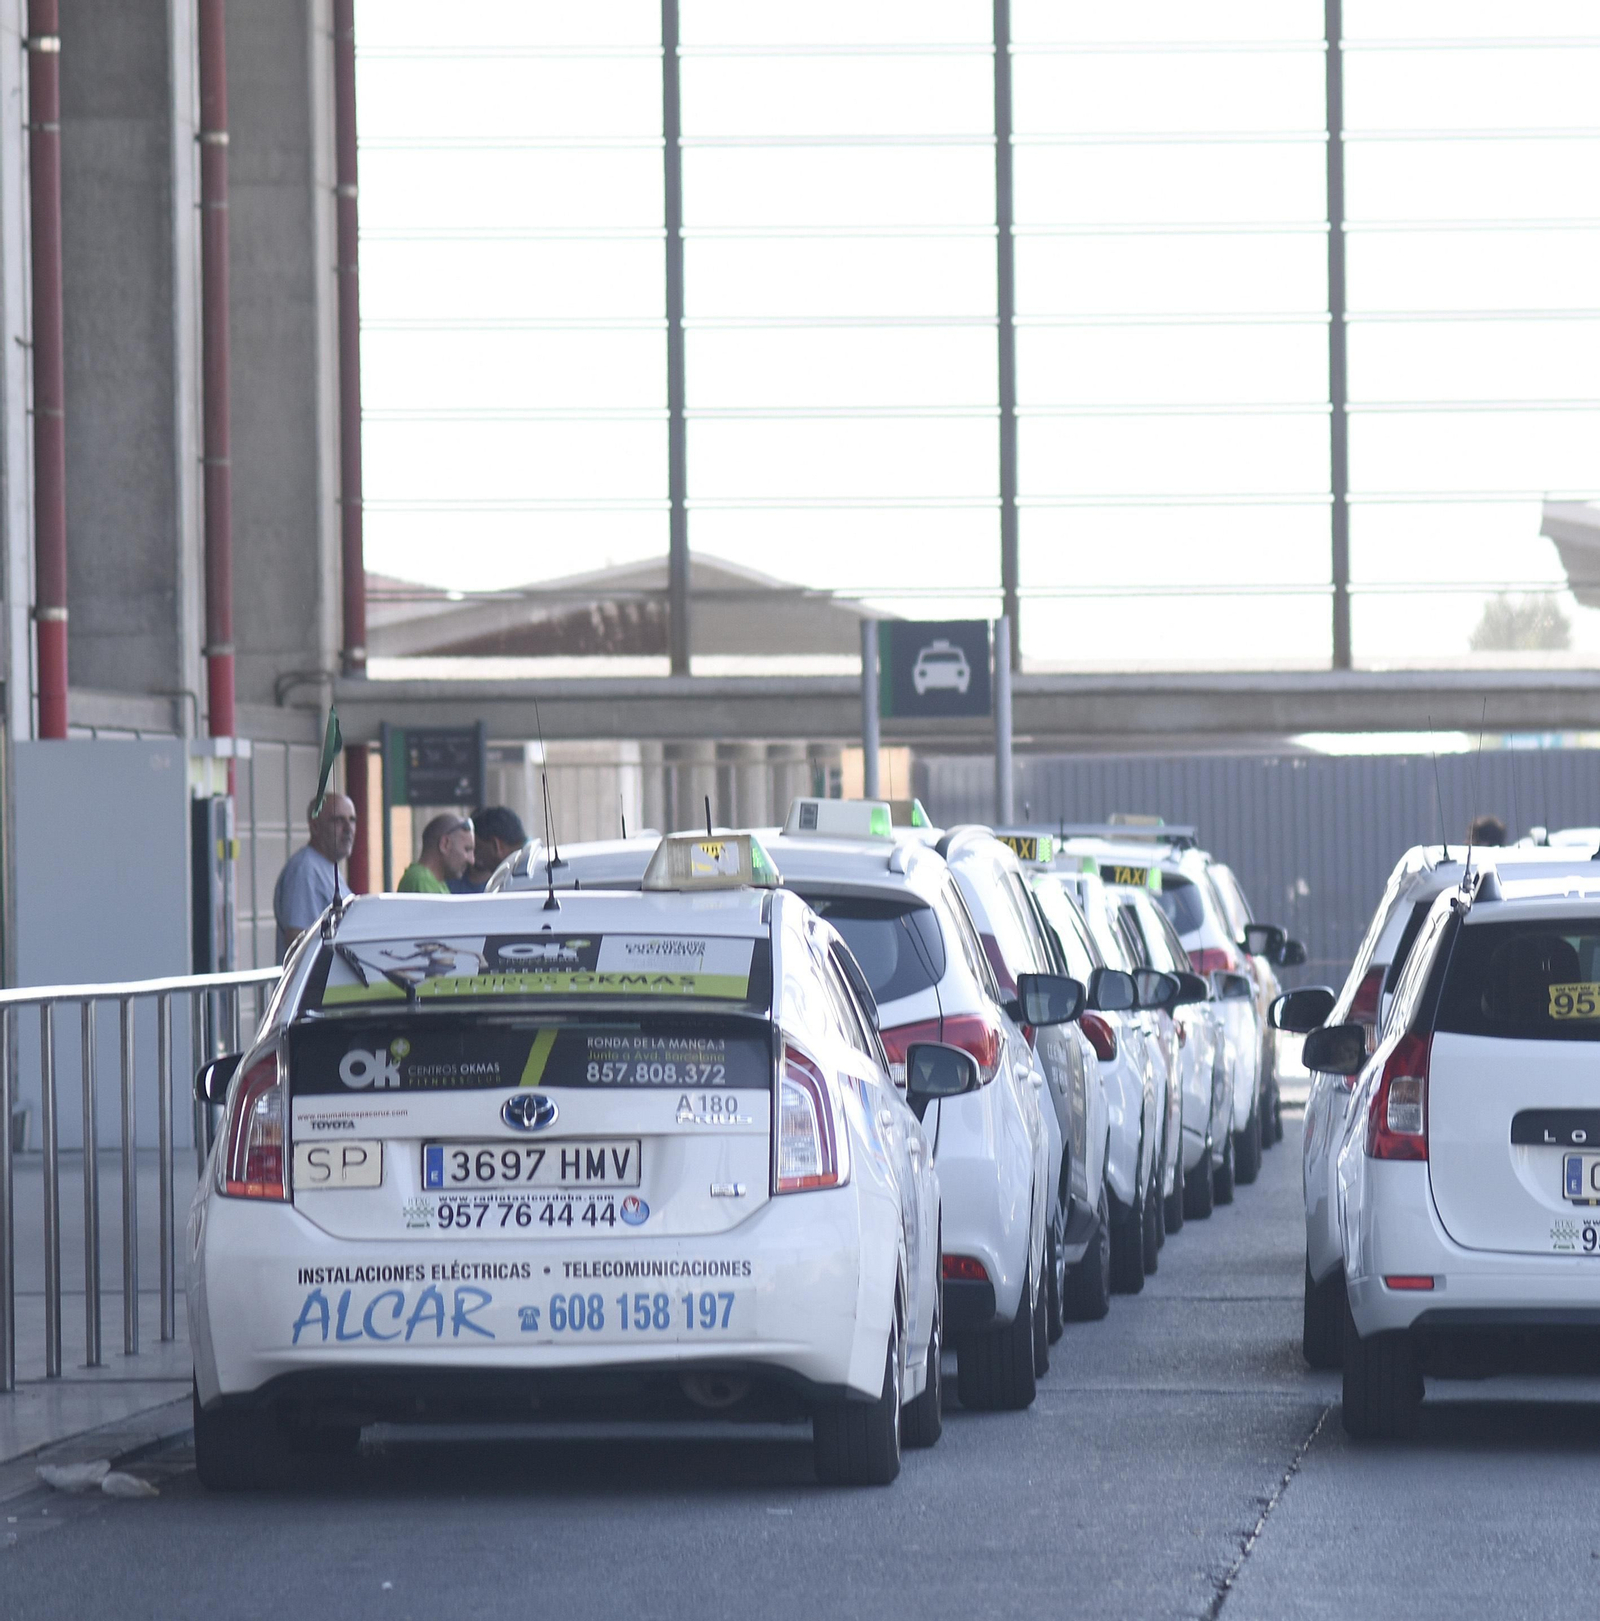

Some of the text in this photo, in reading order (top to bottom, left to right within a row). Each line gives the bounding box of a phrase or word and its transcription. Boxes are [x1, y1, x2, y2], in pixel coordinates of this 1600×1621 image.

[998, 836, 1036, 859] AXI
[1113, 866, 1147, 886] TAXI
[569, 972, 695, 986] OKMAS
[1554, 992, 1600, 1016] 95
[587, 1037, 630, 1049] RONDA
[634, 1037, 648, 1050] DE
[651, 1038, 665, 1050] LA
[665, 1050, 725, 1063] Barcelona
[408, 1061, 500, 1077] CENTROS OKMAS
[586, 1062, 726, 1085] 857.808.372
[676, 1093, 738, 1114] A 180
[311, 1120, 355, 1130] TOYOTA
[430, 1147, 631, 1183] E 3697 HMV
[437, 1203, 616, 1229] 957 76 44 44
[298, 1260, 752, 1285] INSTALACIONES ELÉCTRICAS TELECOMUNICACIONES
[292, 1284, 496, 1345] ALCAR
[549, 1291, 735, 1331] 608 158 197
